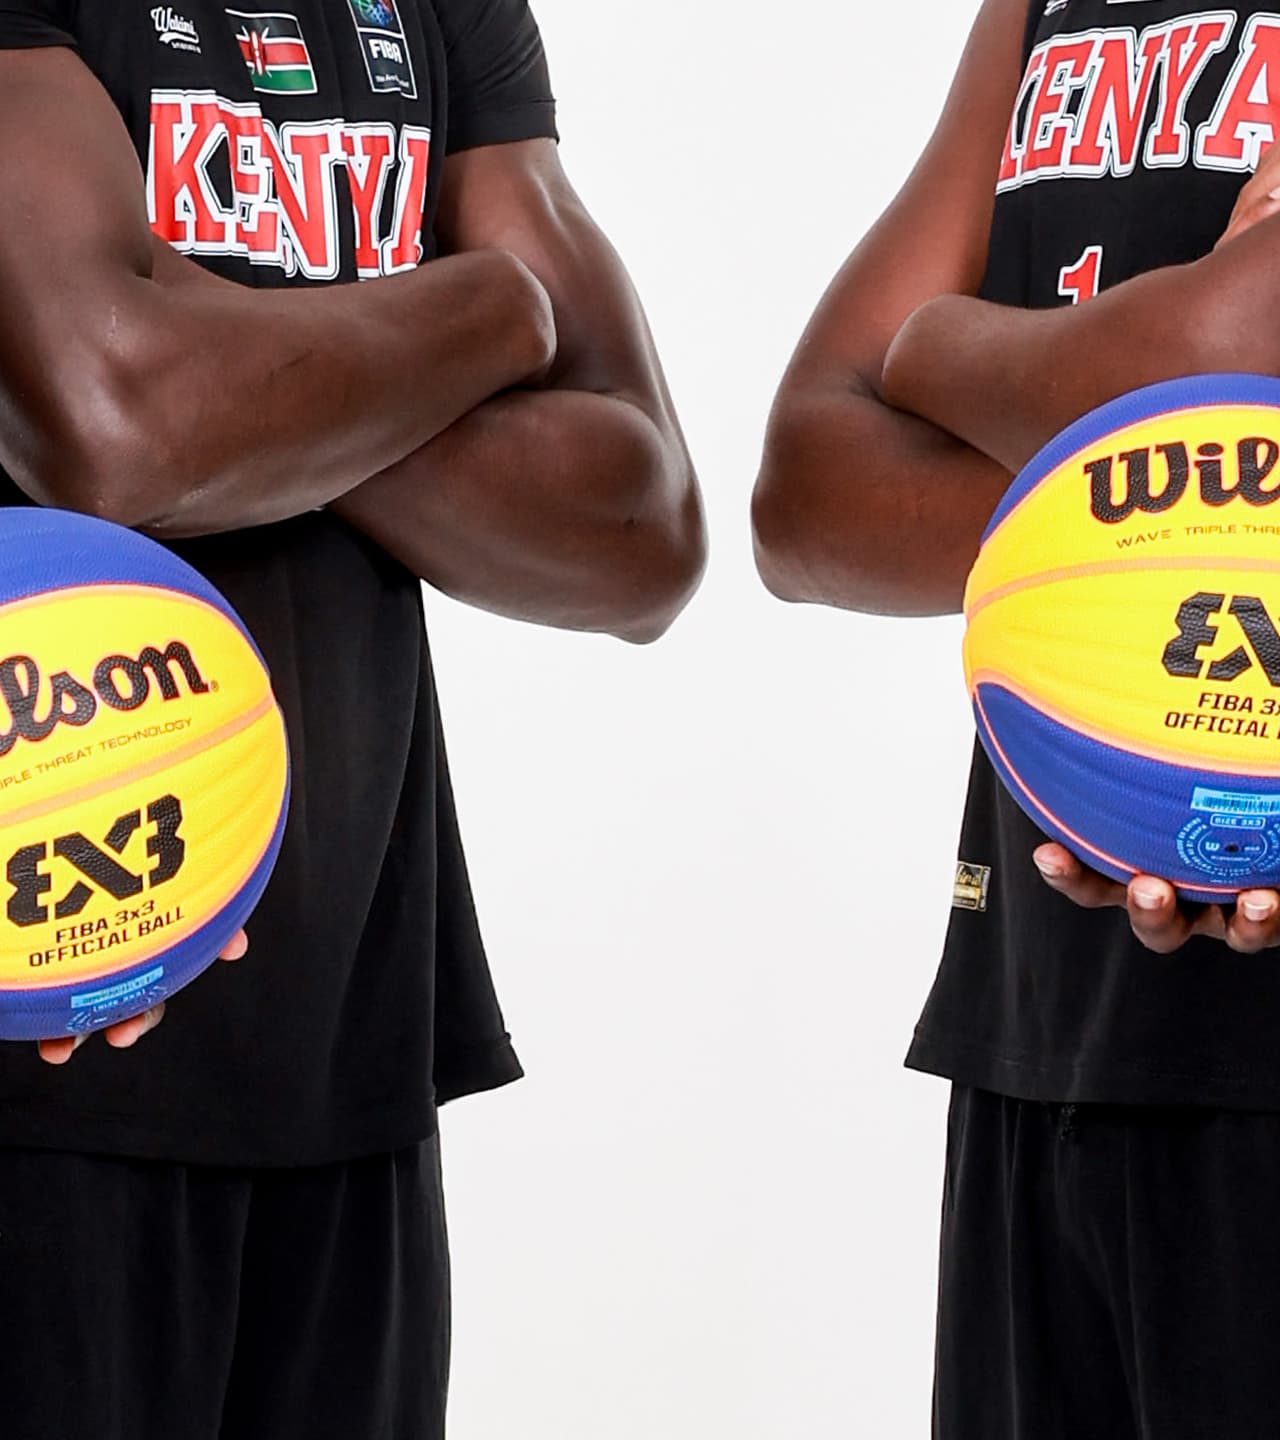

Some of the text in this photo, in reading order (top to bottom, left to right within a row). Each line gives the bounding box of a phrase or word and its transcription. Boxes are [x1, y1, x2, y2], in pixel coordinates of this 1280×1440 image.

[368, 38, 403, 64] FIBA
[1116, 529, 1172, 549] WAVE
[1184, 524, 1238, 537] TRIPLE
[1198, 692, 1254, 713] FIBA
[1164, 711, 1270, 739] OFFICIAL
[36, 745, 95, 775] THREAT
[99, 717, 193, 754] TECHNOLOGY
[28, 906, 185, 968] OFFICIAL BALL
[55, 917, 108, 944] FIBA
